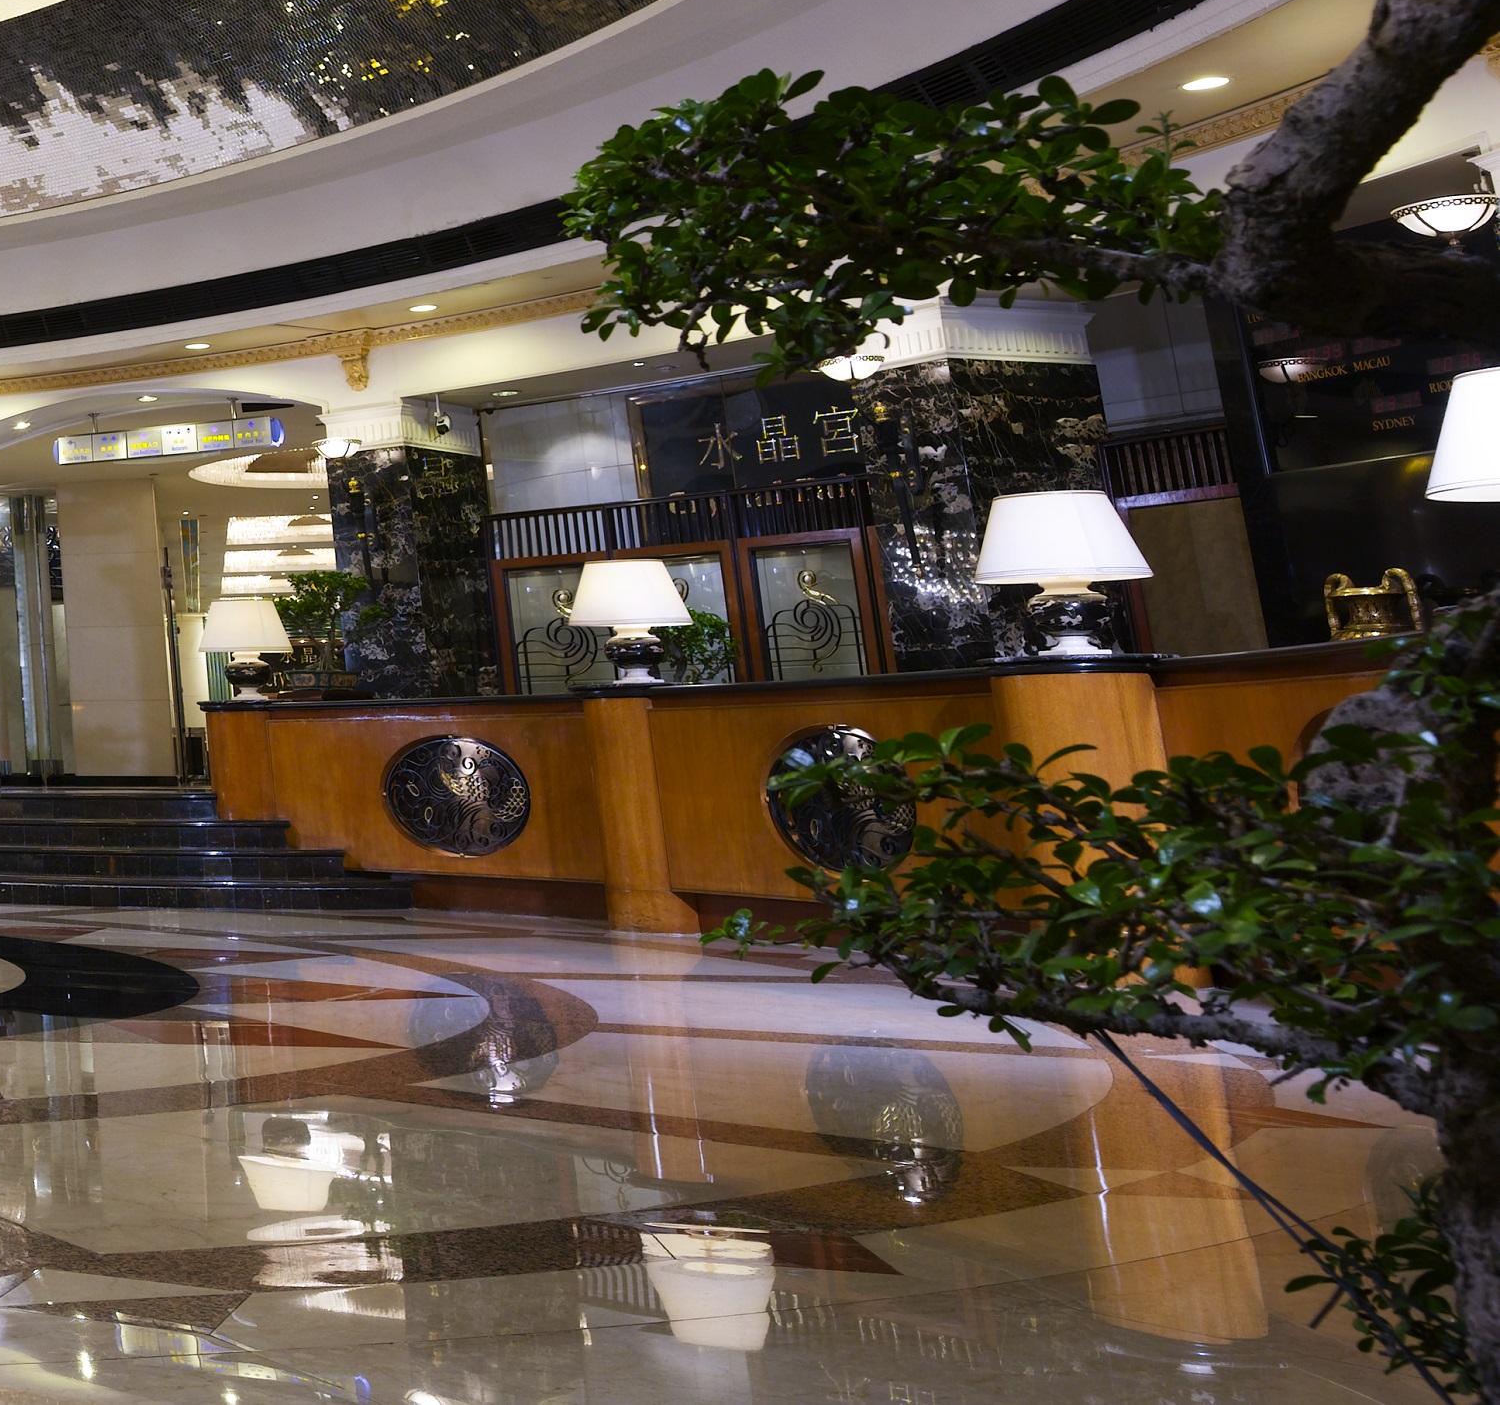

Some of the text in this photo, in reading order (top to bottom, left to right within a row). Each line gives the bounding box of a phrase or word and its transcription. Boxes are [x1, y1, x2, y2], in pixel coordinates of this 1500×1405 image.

[1297, 355, 1392, 383] BANGKOK MACAU
[1372, 415, 1416, 431] SYDNEY
[698, 405, 859, 470] 水晶宮
